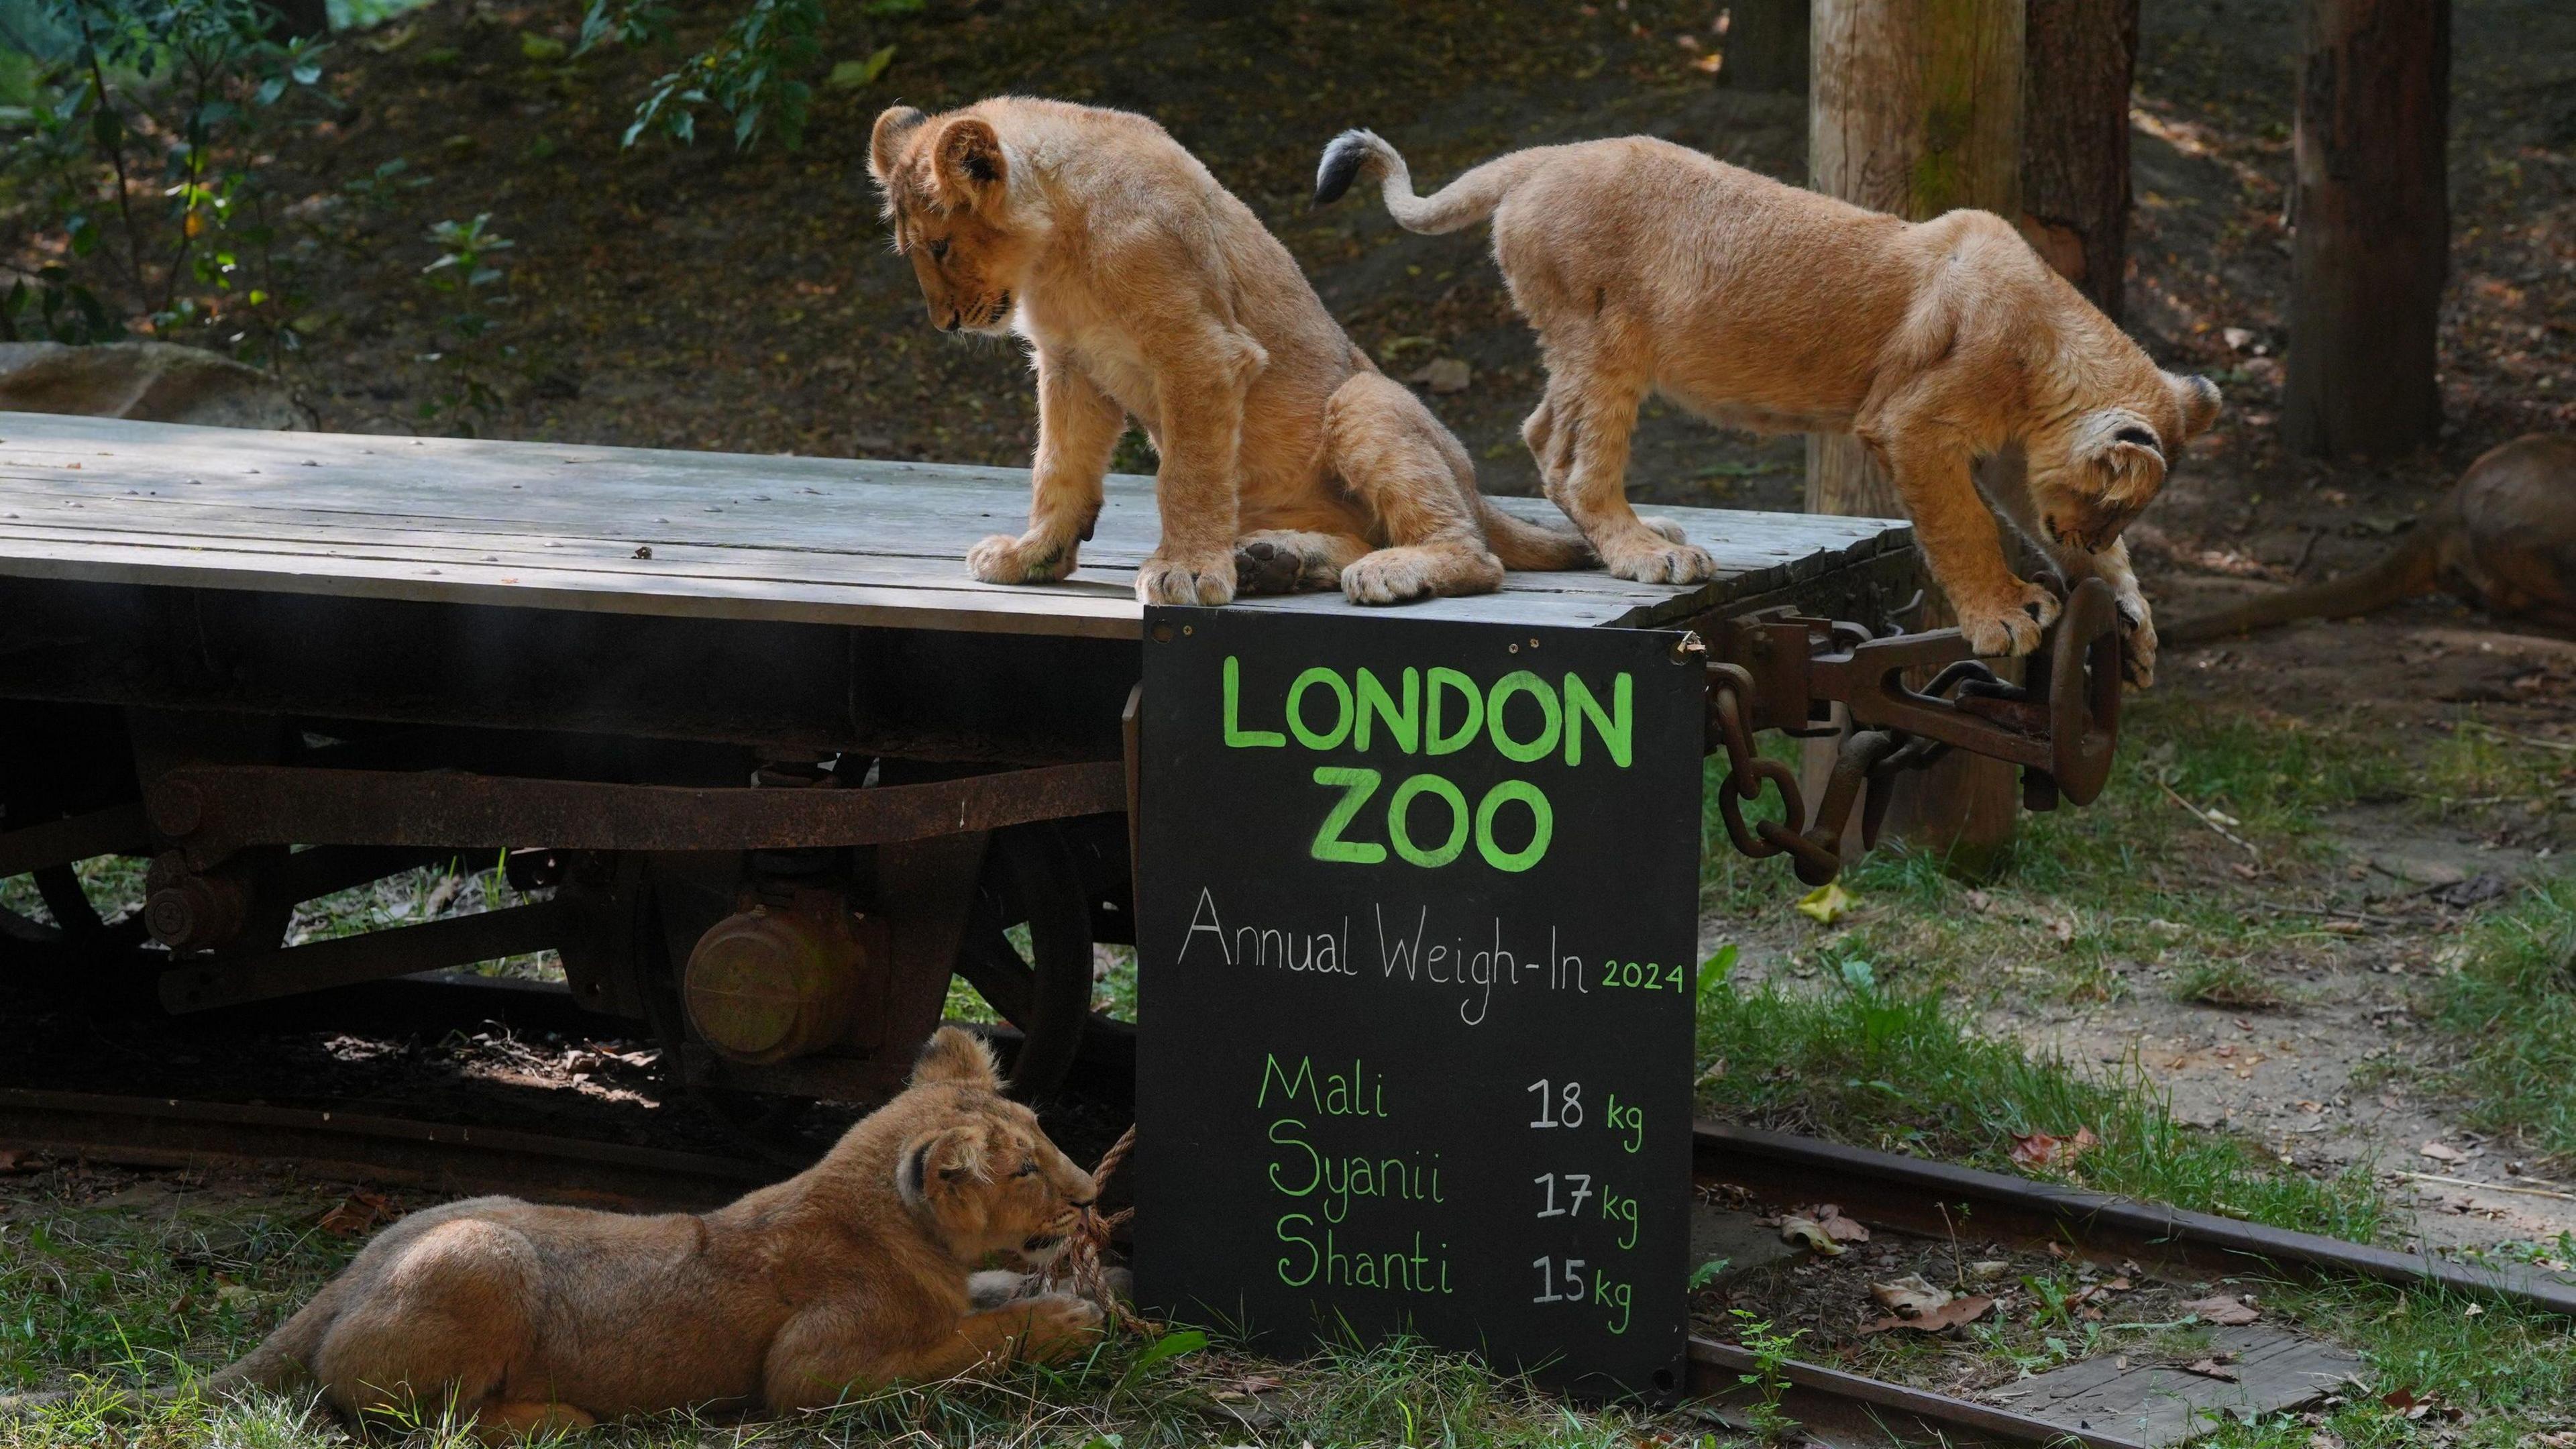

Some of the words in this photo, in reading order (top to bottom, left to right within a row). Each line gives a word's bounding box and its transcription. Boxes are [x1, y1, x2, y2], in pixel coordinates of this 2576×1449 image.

[1223, 655, 1633, 768] LONDON
[1310, 766, 1554, 873] ZOO
[1177, 886, 1358, 976] Annual
[1376, 902, 1589, 1026] Weigh-In
[1602, 960, 1683, 994] 2024
[1257, 1053, 1388, 1117] Mali
[1527, 1078, 1583, 1128] 18
[1607, 1093, 1642, 1153] kg
[1269, 1119, 1444, 1224] Syanii
[1534, 1172, 1593, 1218] 17
[1603, 1185, 1638, 1250] kg
[1277, 1211, 1453, 1293] Shanti
[1533, 1255, 1585, 1303] 15
[1595, 1269, 1631, 1334] kg
